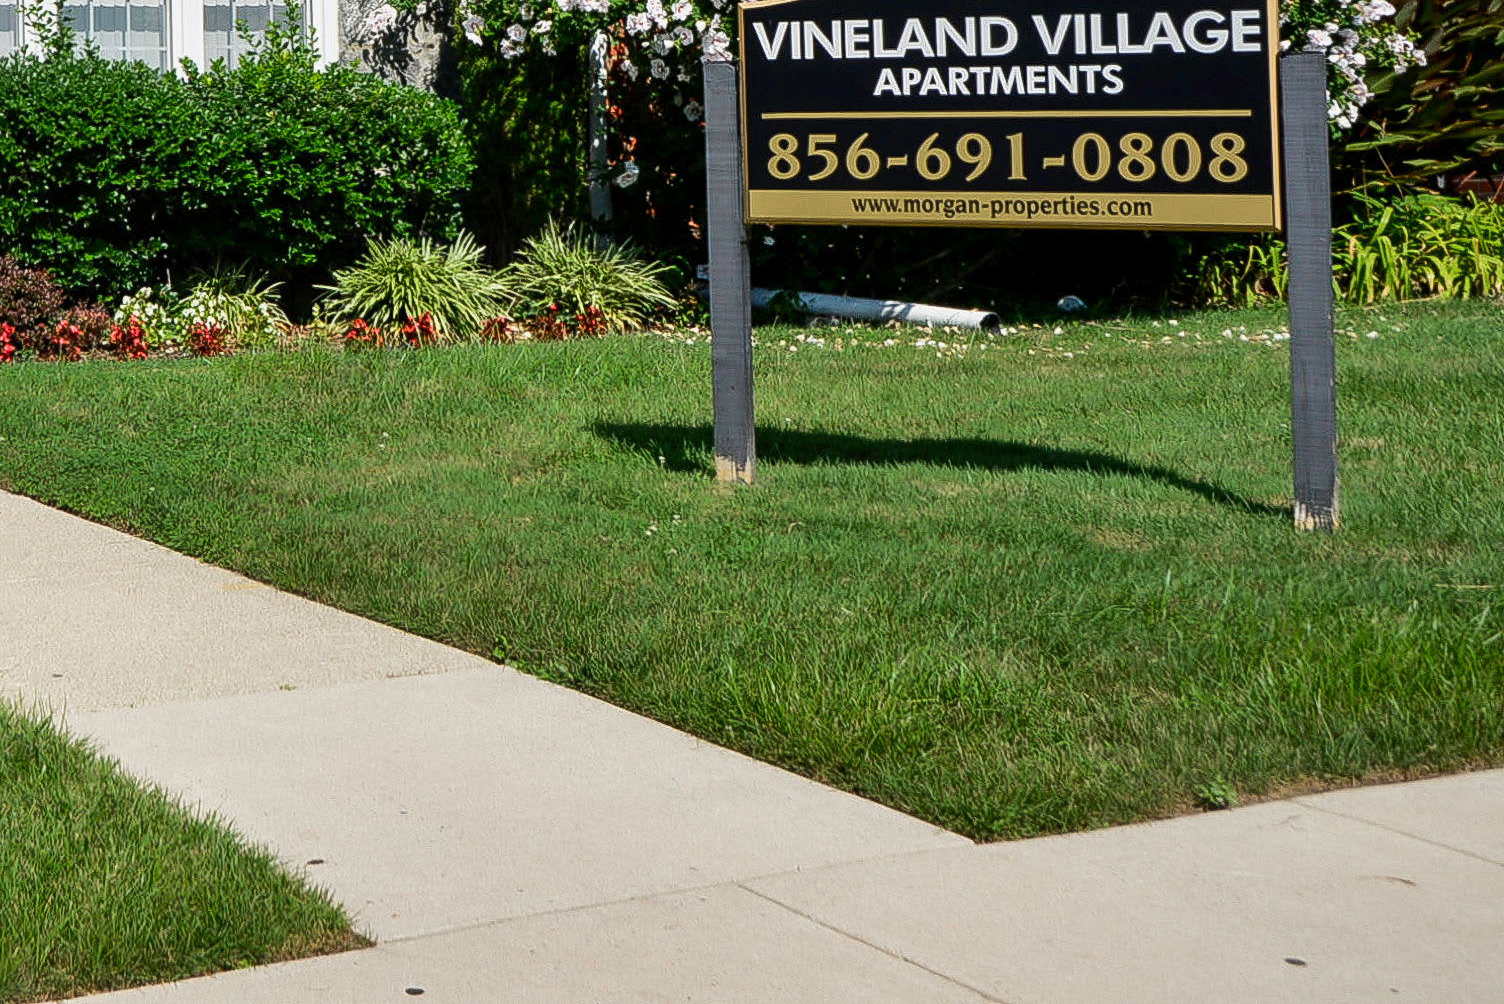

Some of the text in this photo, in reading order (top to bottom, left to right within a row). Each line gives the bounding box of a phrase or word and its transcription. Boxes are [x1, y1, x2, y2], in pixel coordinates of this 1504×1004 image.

[753, 9, 1263, 60] VINELAND VILLAGE
[873, 64, 1124, 96] APARTMENTS
[766, 132, 1249, 184] 856-691-0808
[851, 195, 1153, 219] www.morgan-properties.com
